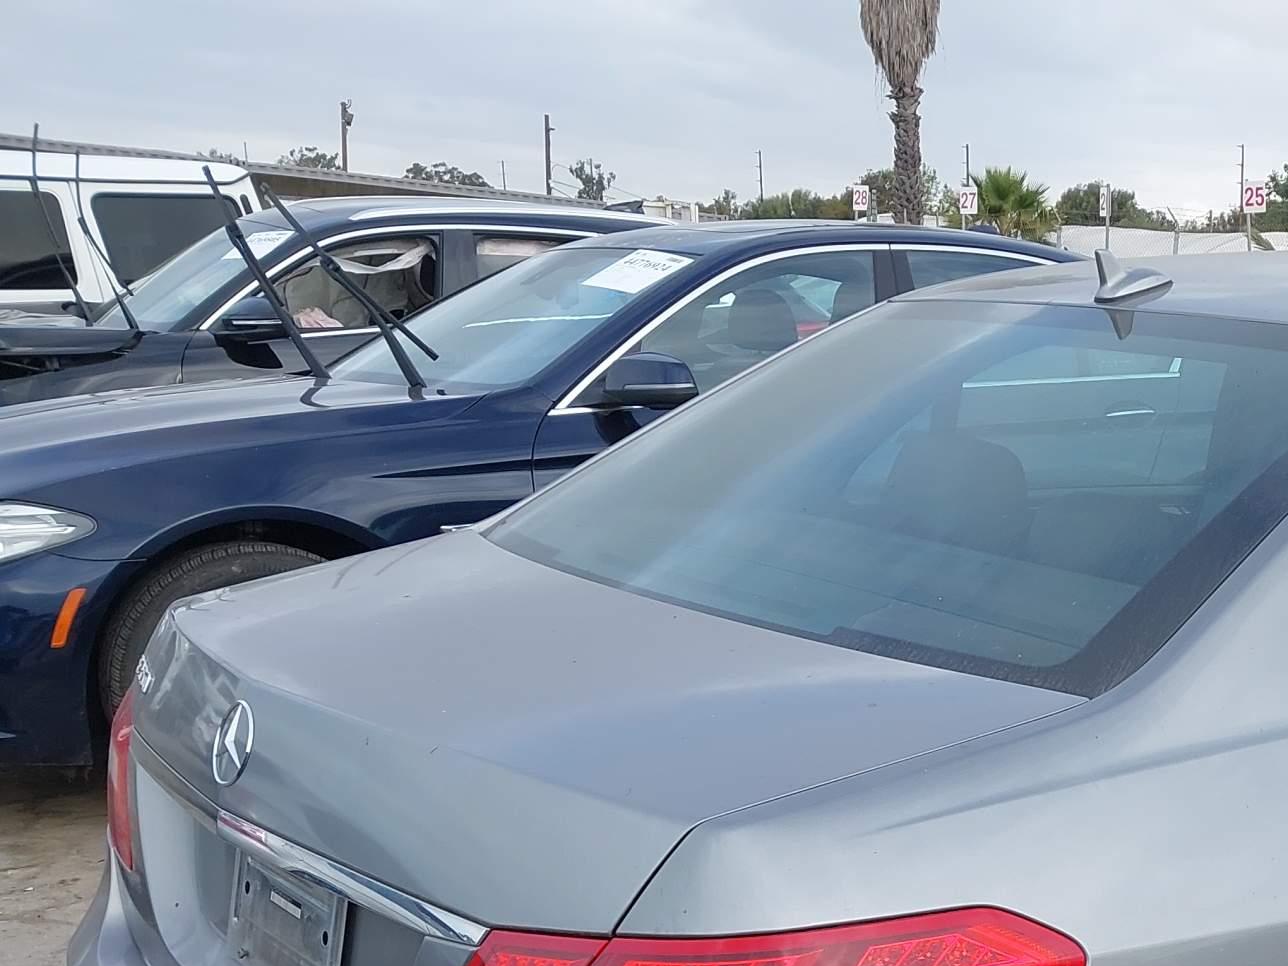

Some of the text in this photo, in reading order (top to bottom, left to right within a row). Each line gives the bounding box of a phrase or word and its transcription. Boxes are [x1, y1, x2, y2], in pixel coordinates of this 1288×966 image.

[854, 189, 868, 206] 28
[960, 191, 977, 209] 27
[1244, 186, 1265, 207] 25
